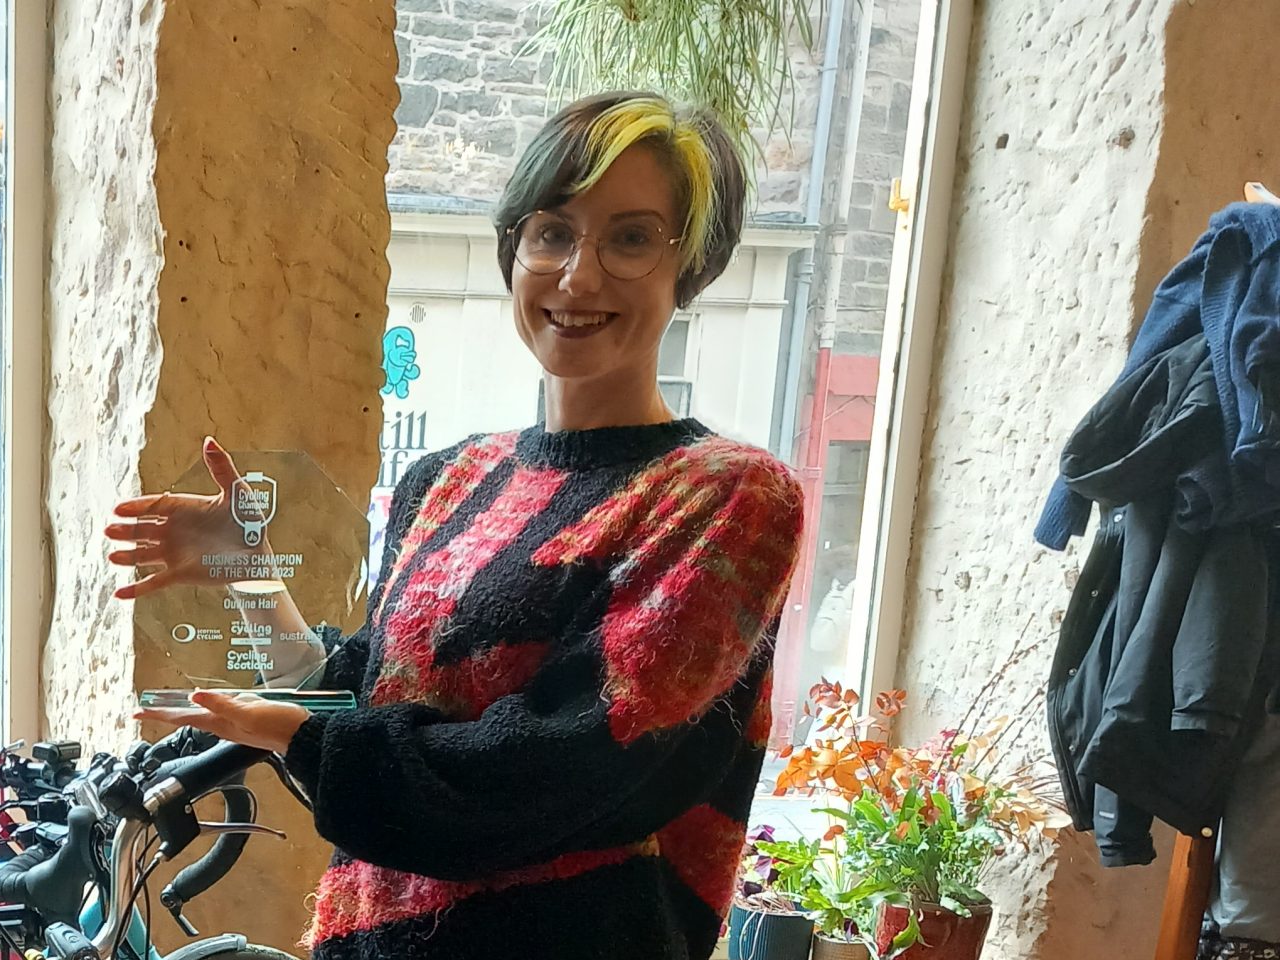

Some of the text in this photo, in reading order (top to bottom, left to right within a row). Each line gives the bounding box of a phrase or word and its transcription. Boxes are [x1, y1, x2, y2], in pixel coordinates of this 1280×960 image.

[239, 489, 269, 502] Cycling
[202, 553, 303, 566] BUSINESS CHAMPION
[209, 567, 294, 578] OF THE YEAR 2023
[258, 597, 278, 609] Hair
[227, 649, 267, 662] Cycling
[227, 659, 273, 670] Scotland
